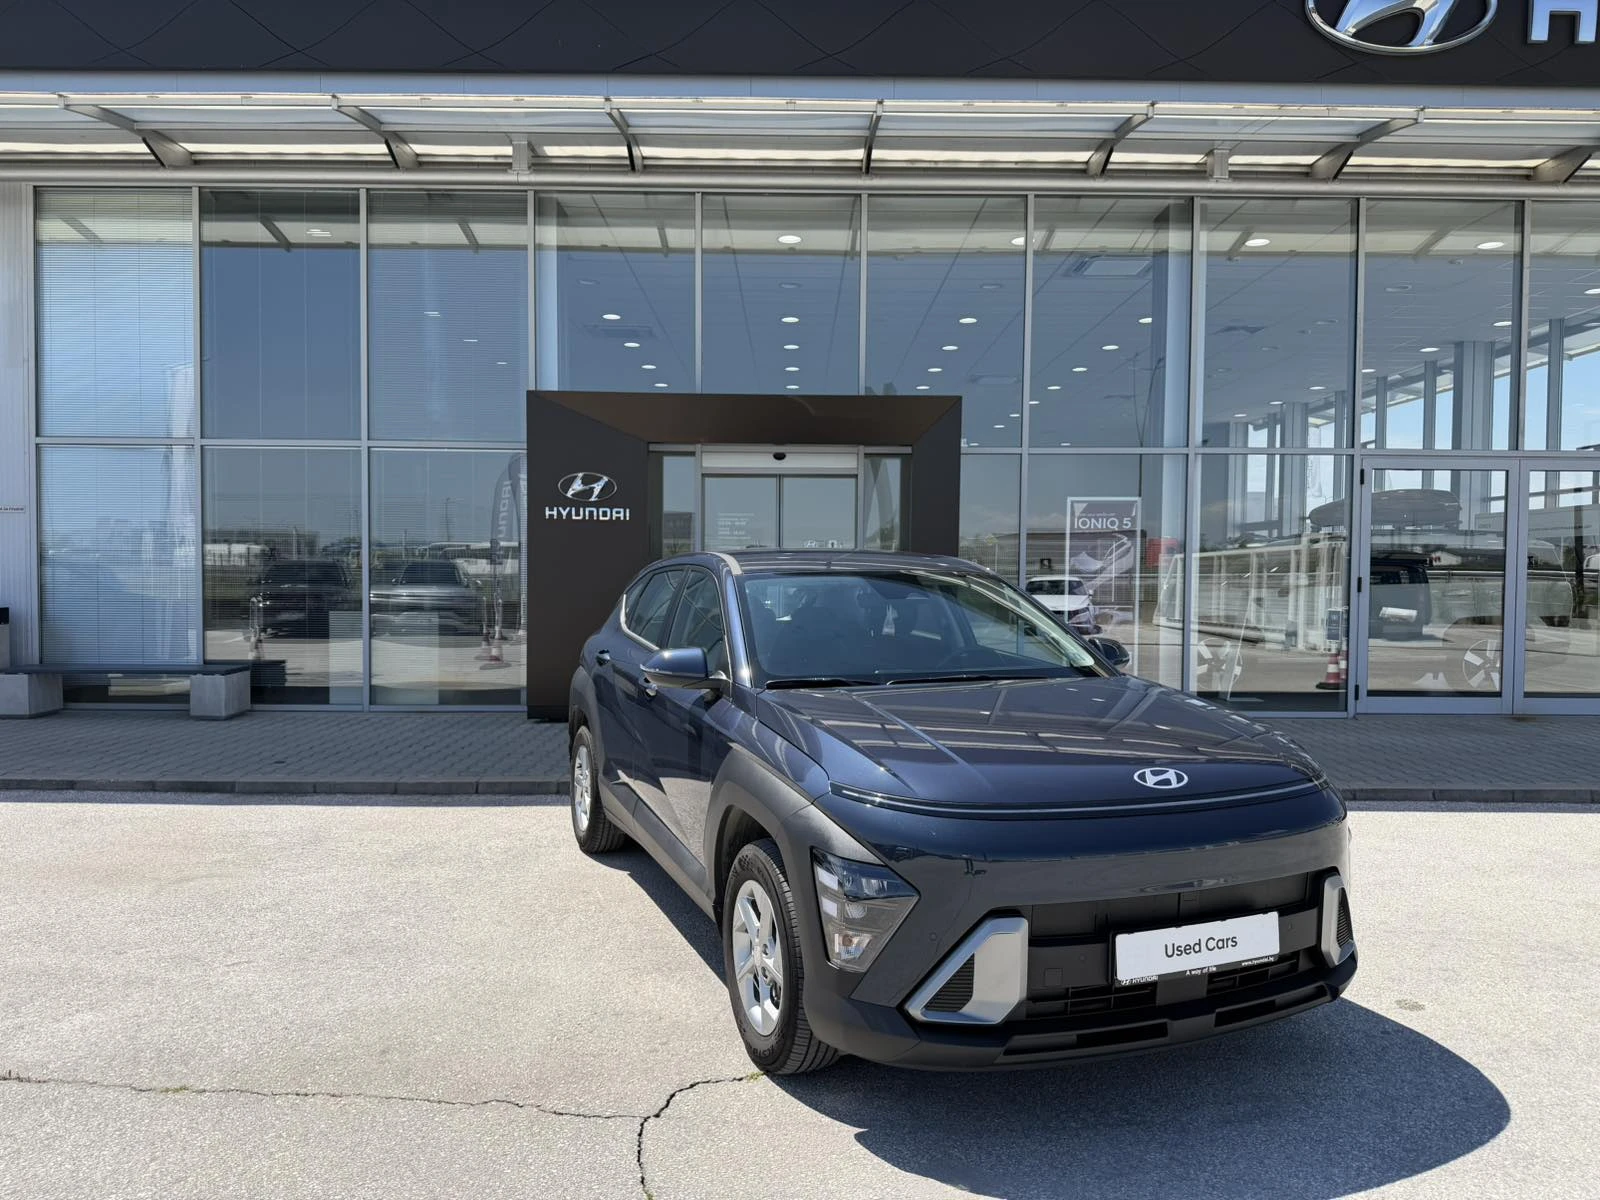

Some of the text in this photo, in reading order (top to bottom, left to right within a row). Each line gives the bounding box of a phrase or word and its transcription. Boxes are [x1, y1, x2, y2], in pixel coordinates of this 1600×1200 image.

[545, 506, 630, 521] HYUNDAI
[1074, 516, 1132, 531] IONIQ 5
[1164, 936, 1238, 958] Used Cars
[1132, 974, 1159, 984] HYUNDAI
